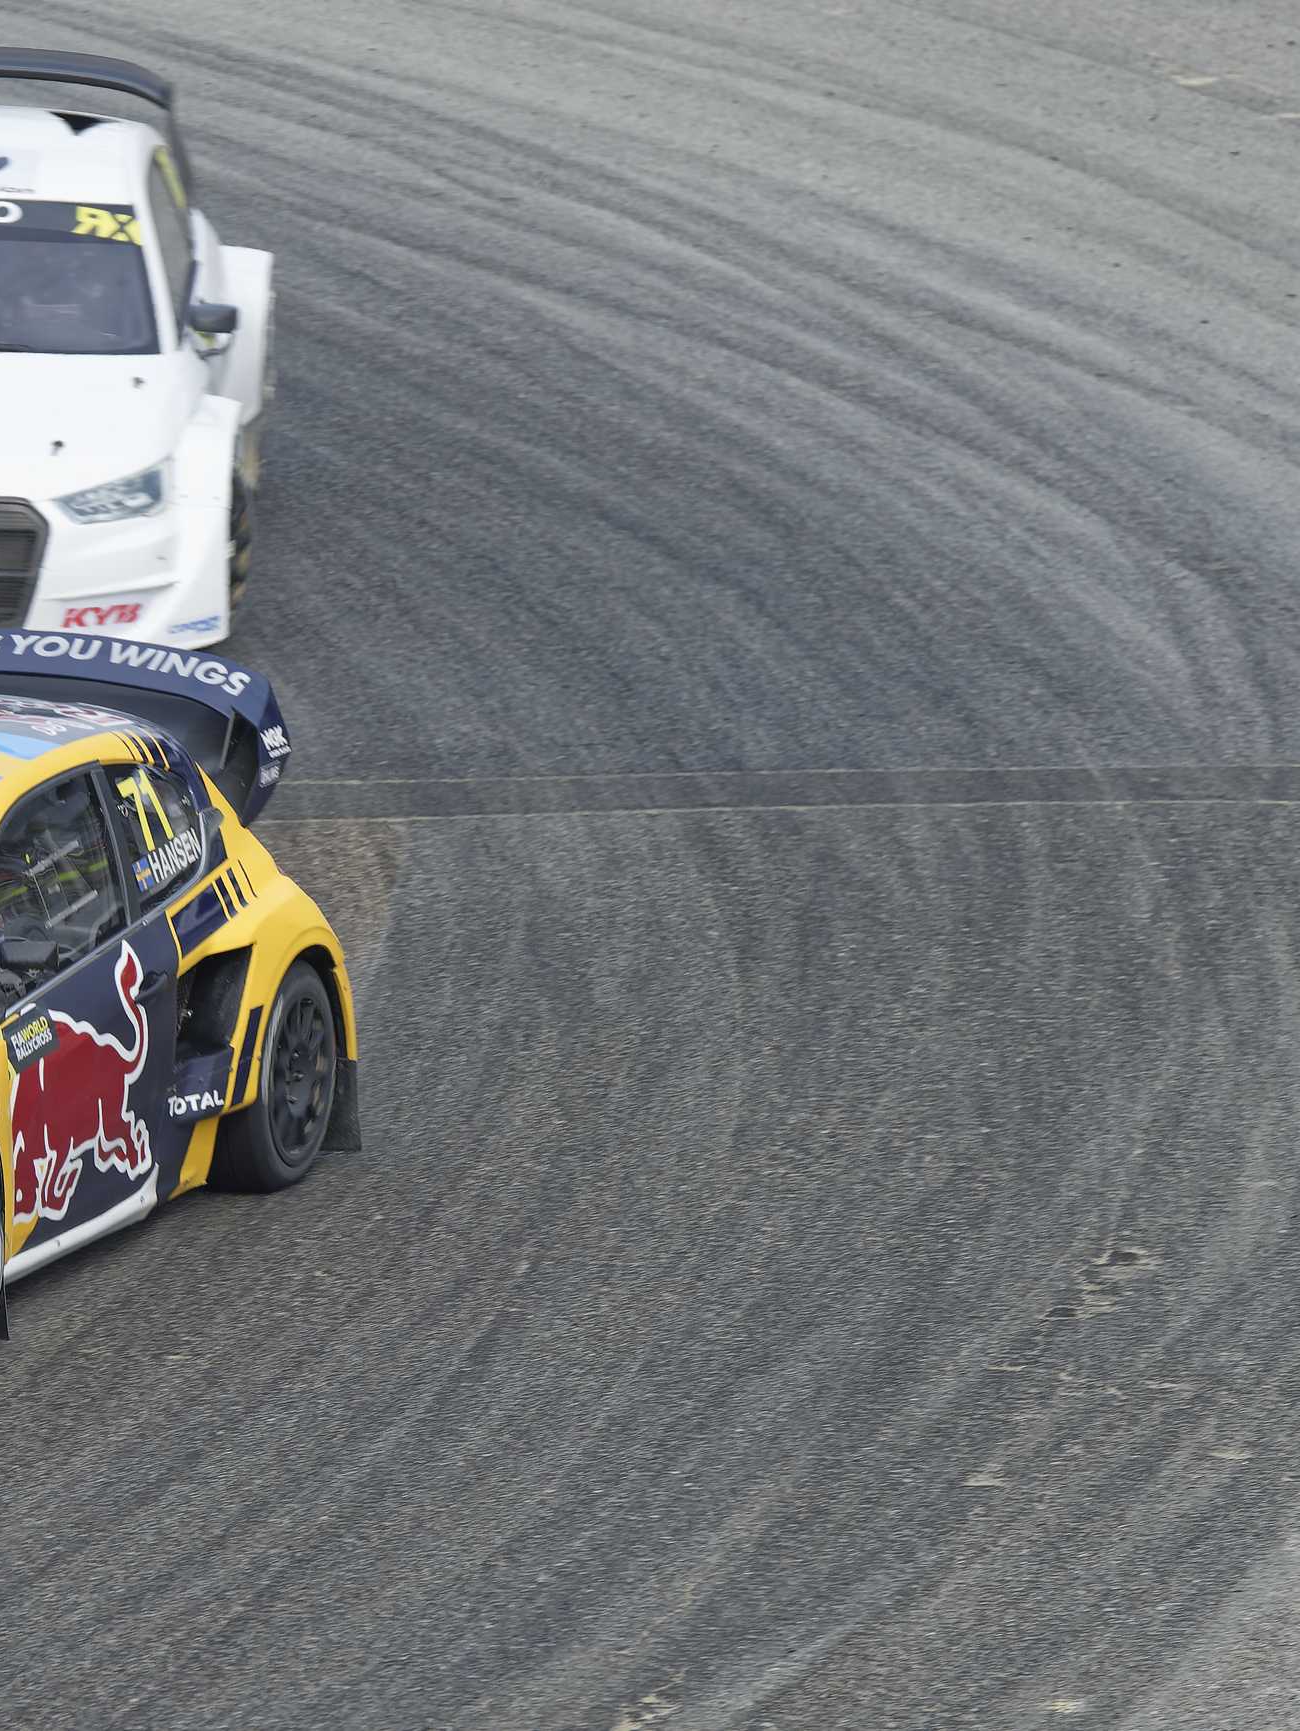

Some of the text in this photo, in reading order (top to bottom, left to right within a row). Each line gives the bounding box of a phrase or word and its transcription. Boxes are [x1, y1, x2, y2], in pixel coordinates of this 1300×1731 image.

[61, 602, 143, 629] KYB
[9, 634, 102, 661] YOU
[108, 642, 251, 697] WINGS
[116, 768, 175, 852] 71
[147, 827, 202, 884] HANSEN
[14, 1027, 53, 1062] RALLYCROSS
[167, 1089, 225, 1118] TOTAL
